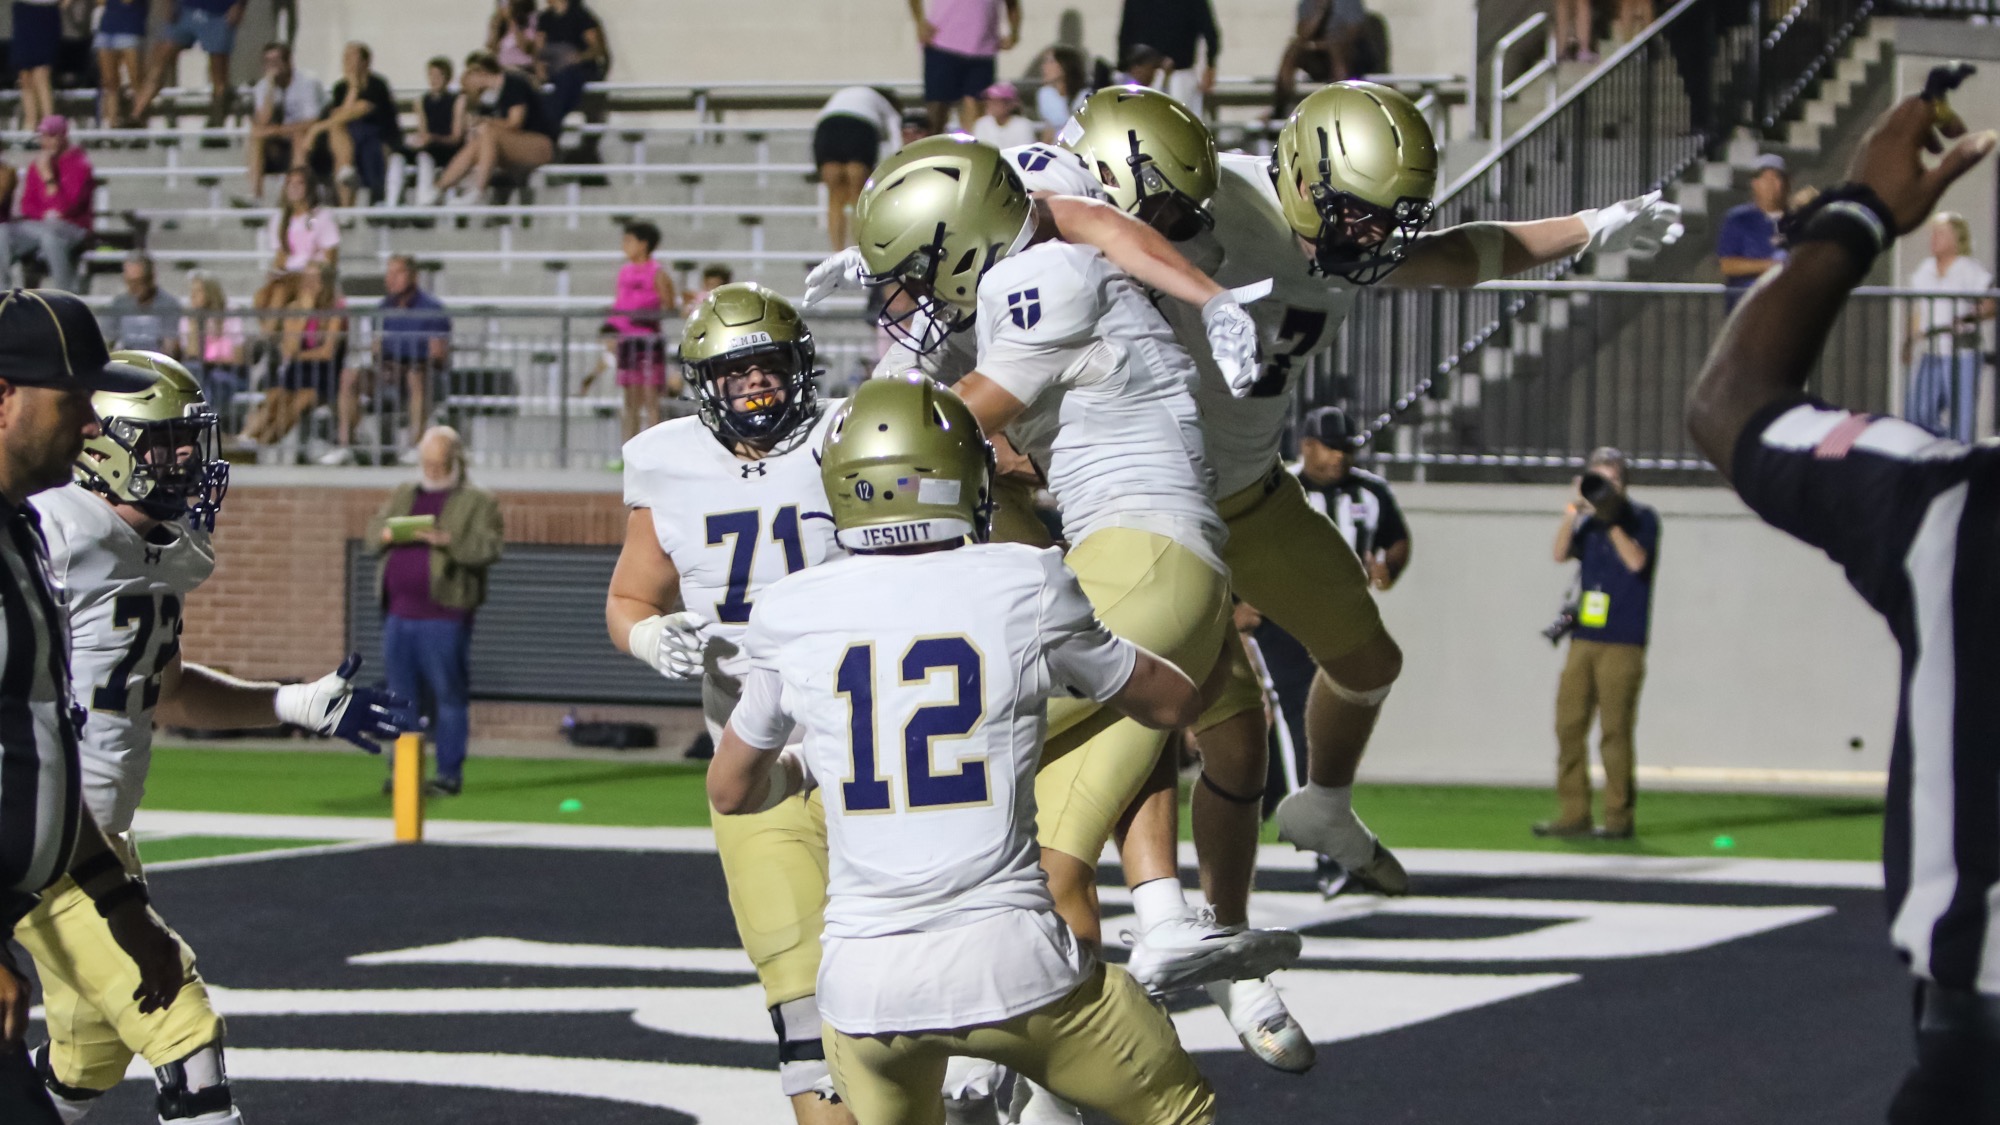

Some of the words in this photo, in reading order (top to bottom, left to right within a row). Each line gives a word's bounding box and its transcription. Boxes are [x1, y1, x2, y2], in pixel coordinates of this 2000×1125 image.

[857, 482, 871, 499] 12
[703, 502, 809, 625] 71
[861, 522, 931, 547] JESUIT
[833, 632, 993, 816] 12
